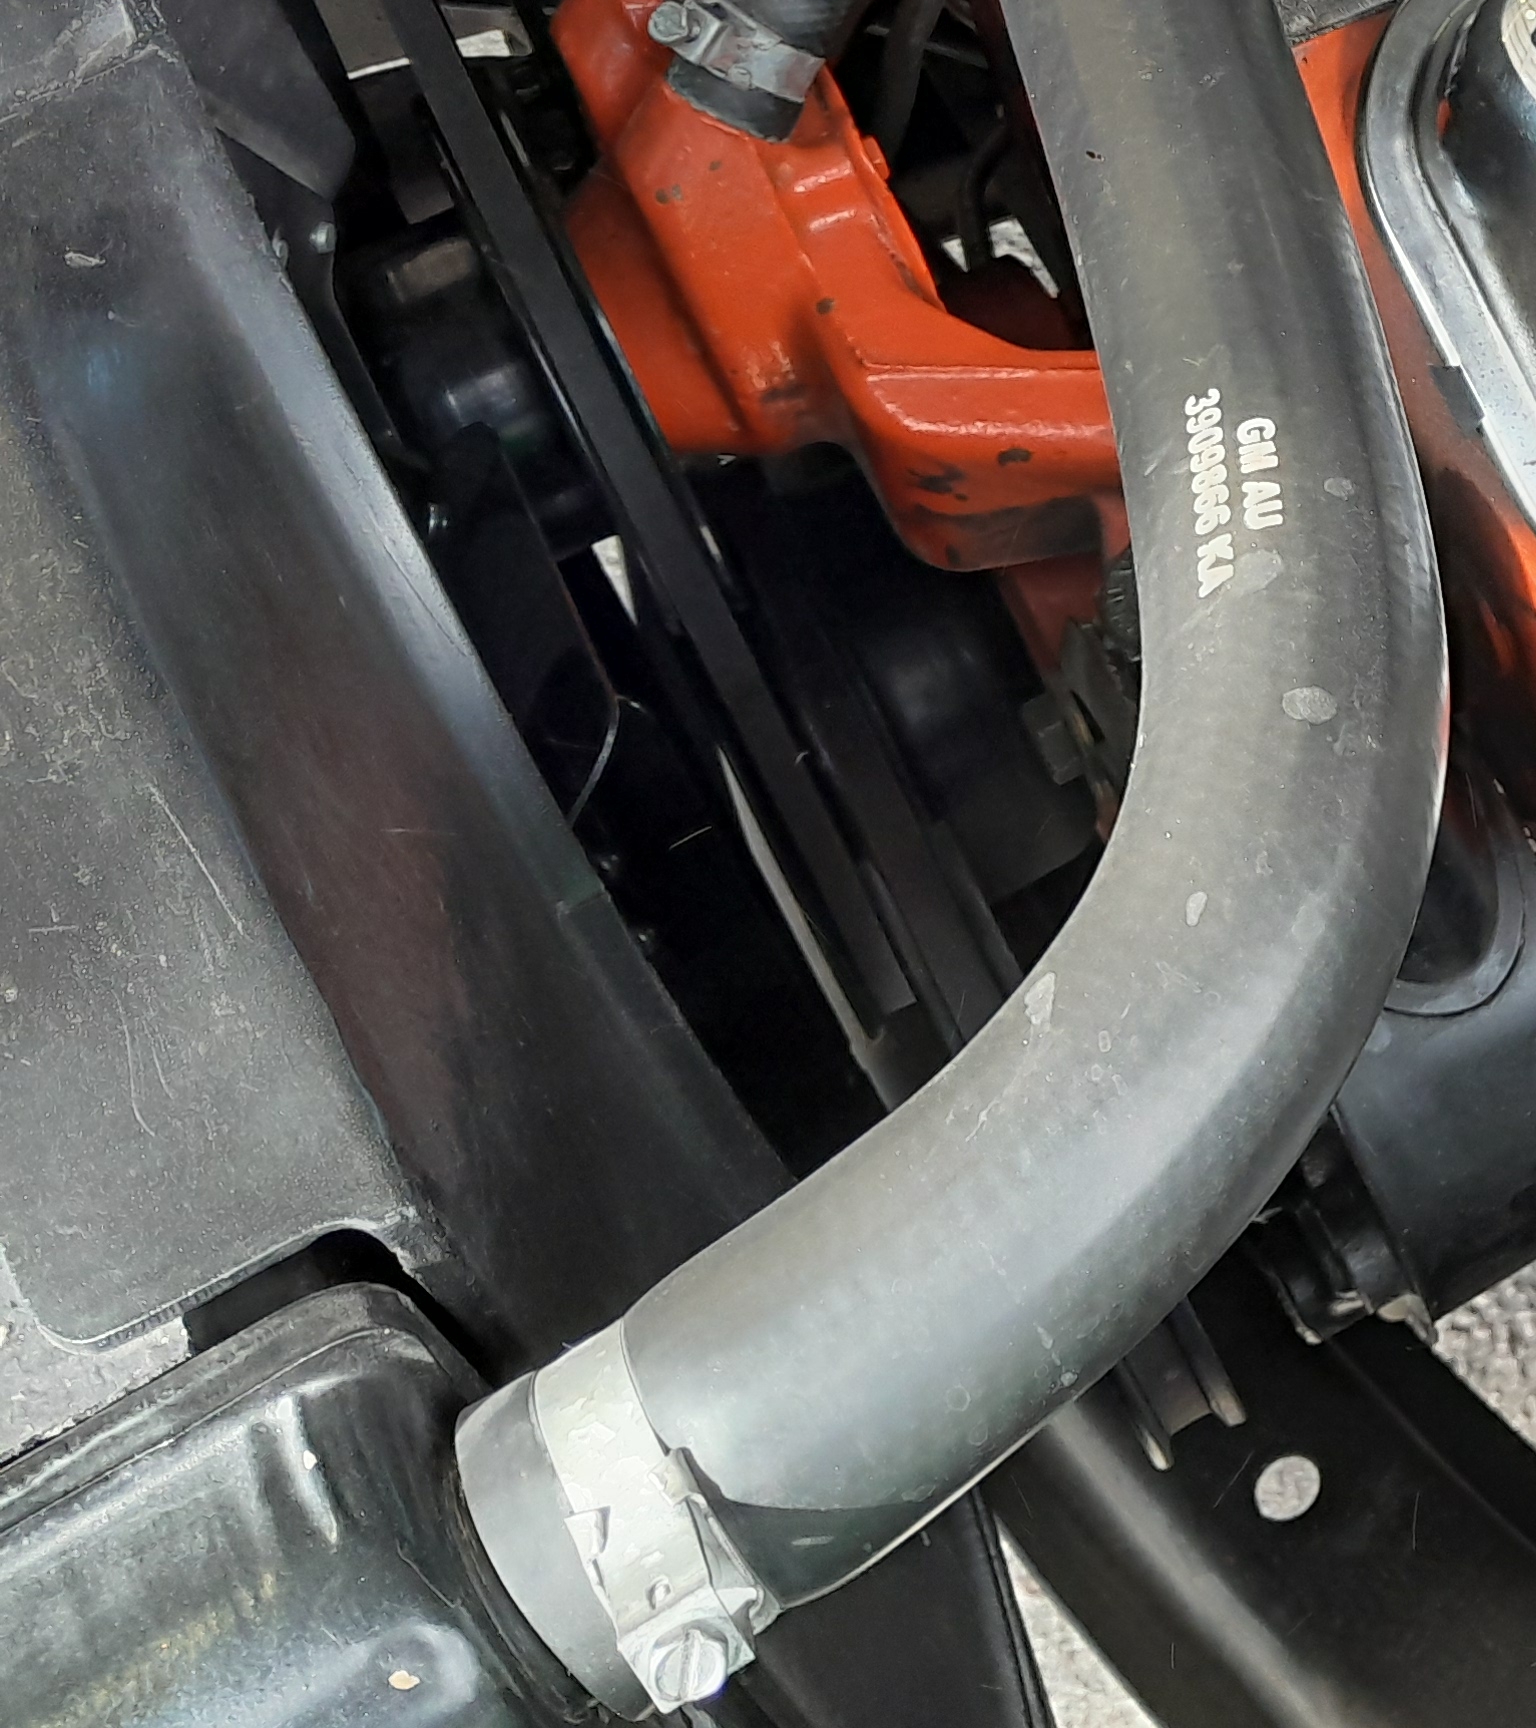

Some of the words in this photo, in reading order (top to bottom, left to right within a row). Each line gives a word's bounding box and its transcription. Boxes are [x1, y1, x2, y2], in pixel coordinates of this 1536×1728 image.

[1183, 388, 1231, 535] 3909866
[1235, 416, 1279, 473] GM
[1240, 479, 1284, 531] AU
[1197, 533, 1235, 598] KA
